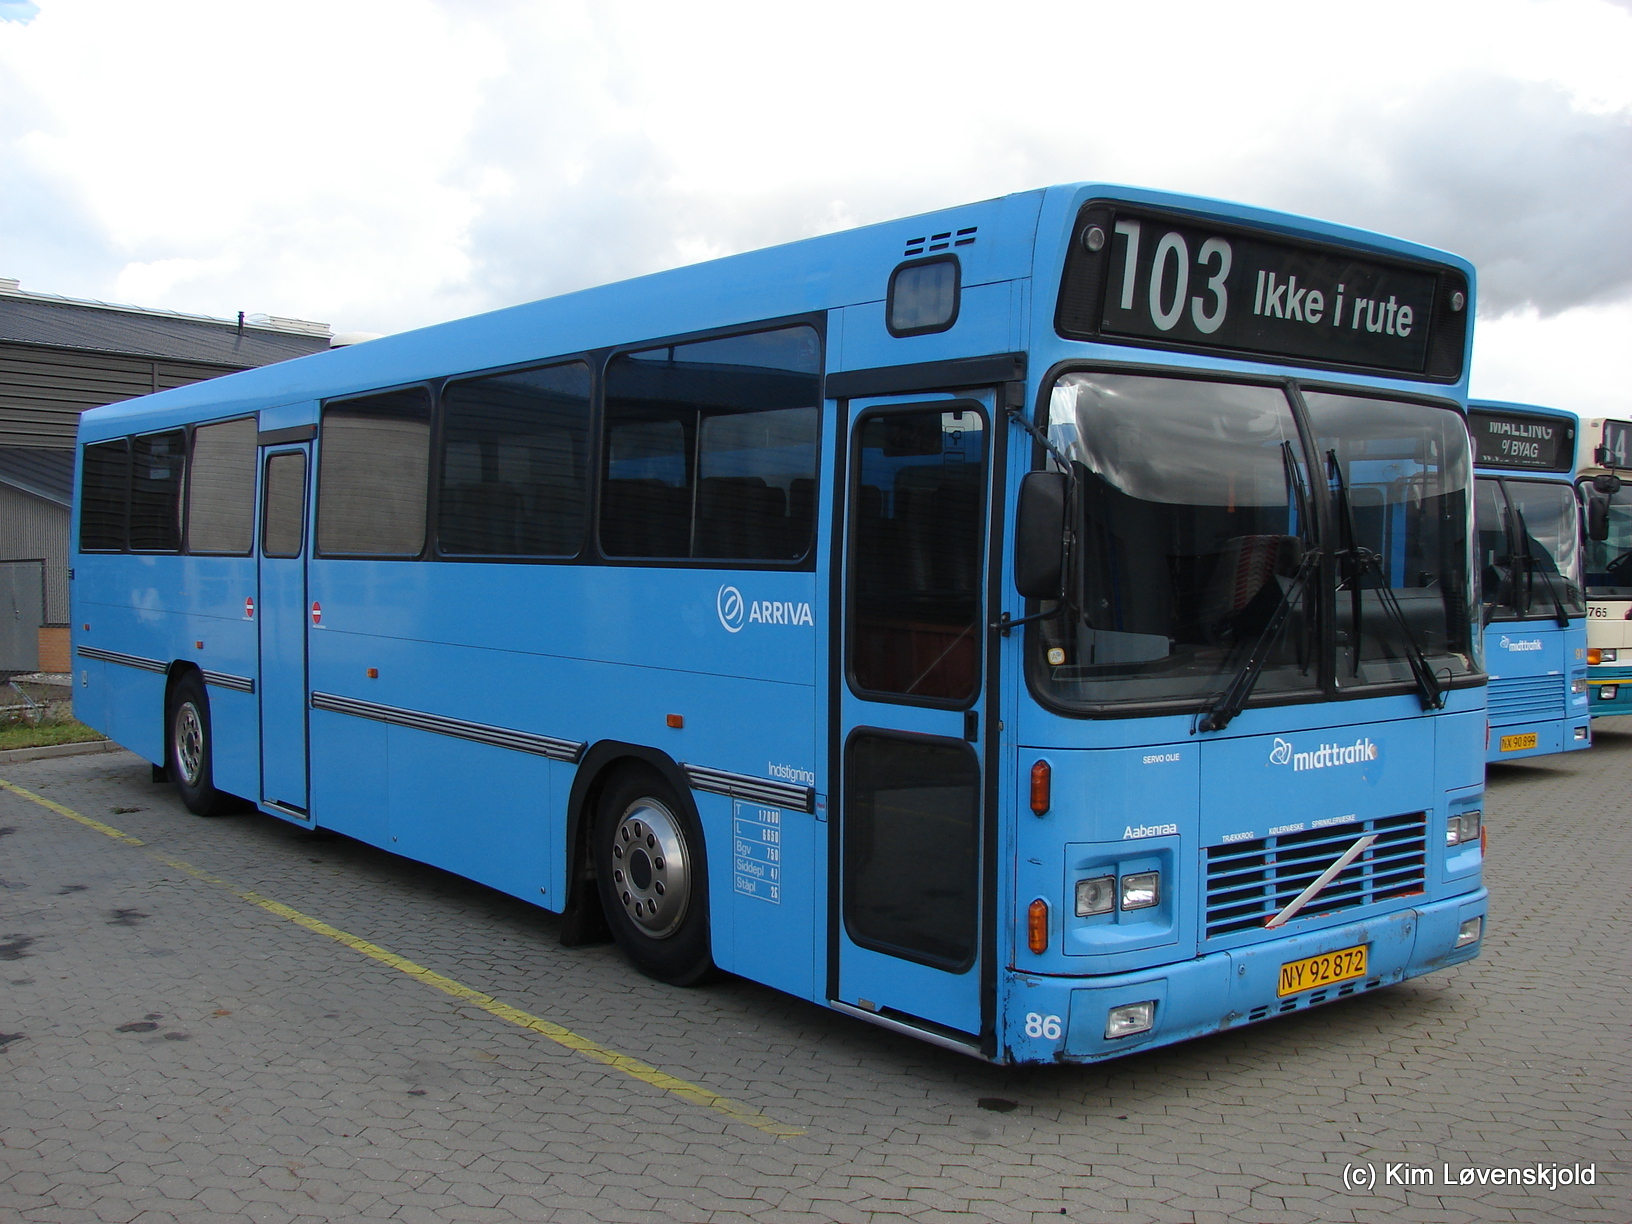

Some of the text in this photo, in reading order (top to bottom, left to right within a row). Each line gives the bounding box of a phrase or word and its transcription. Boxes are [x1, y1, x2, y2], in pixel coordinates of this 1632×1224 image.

[1115, 220, 1232, 334] 103
[1254, 270, 1413, 337] Ikke i rute
[749, 601, 814, 626] ARRIVA
[1143, 753, 1180, 764] SERVO OLIE
[1294, 738, 1377, 771] midttrafik
[768, 761, 814, 786] Indstigning
[736, 803, 742, 815] T
[736, 821, 742, 834] L
[1122, 824, 1177, 840] Aabenraa
[736, 840, 779, 861] Bgv 750
[736, 858, 765, 877] Siddepl
[736, 876, 756, 893] Ståpl
[1281, 971, 1305, 991] NY
[1025, 1012, 1062, 1040] 86
